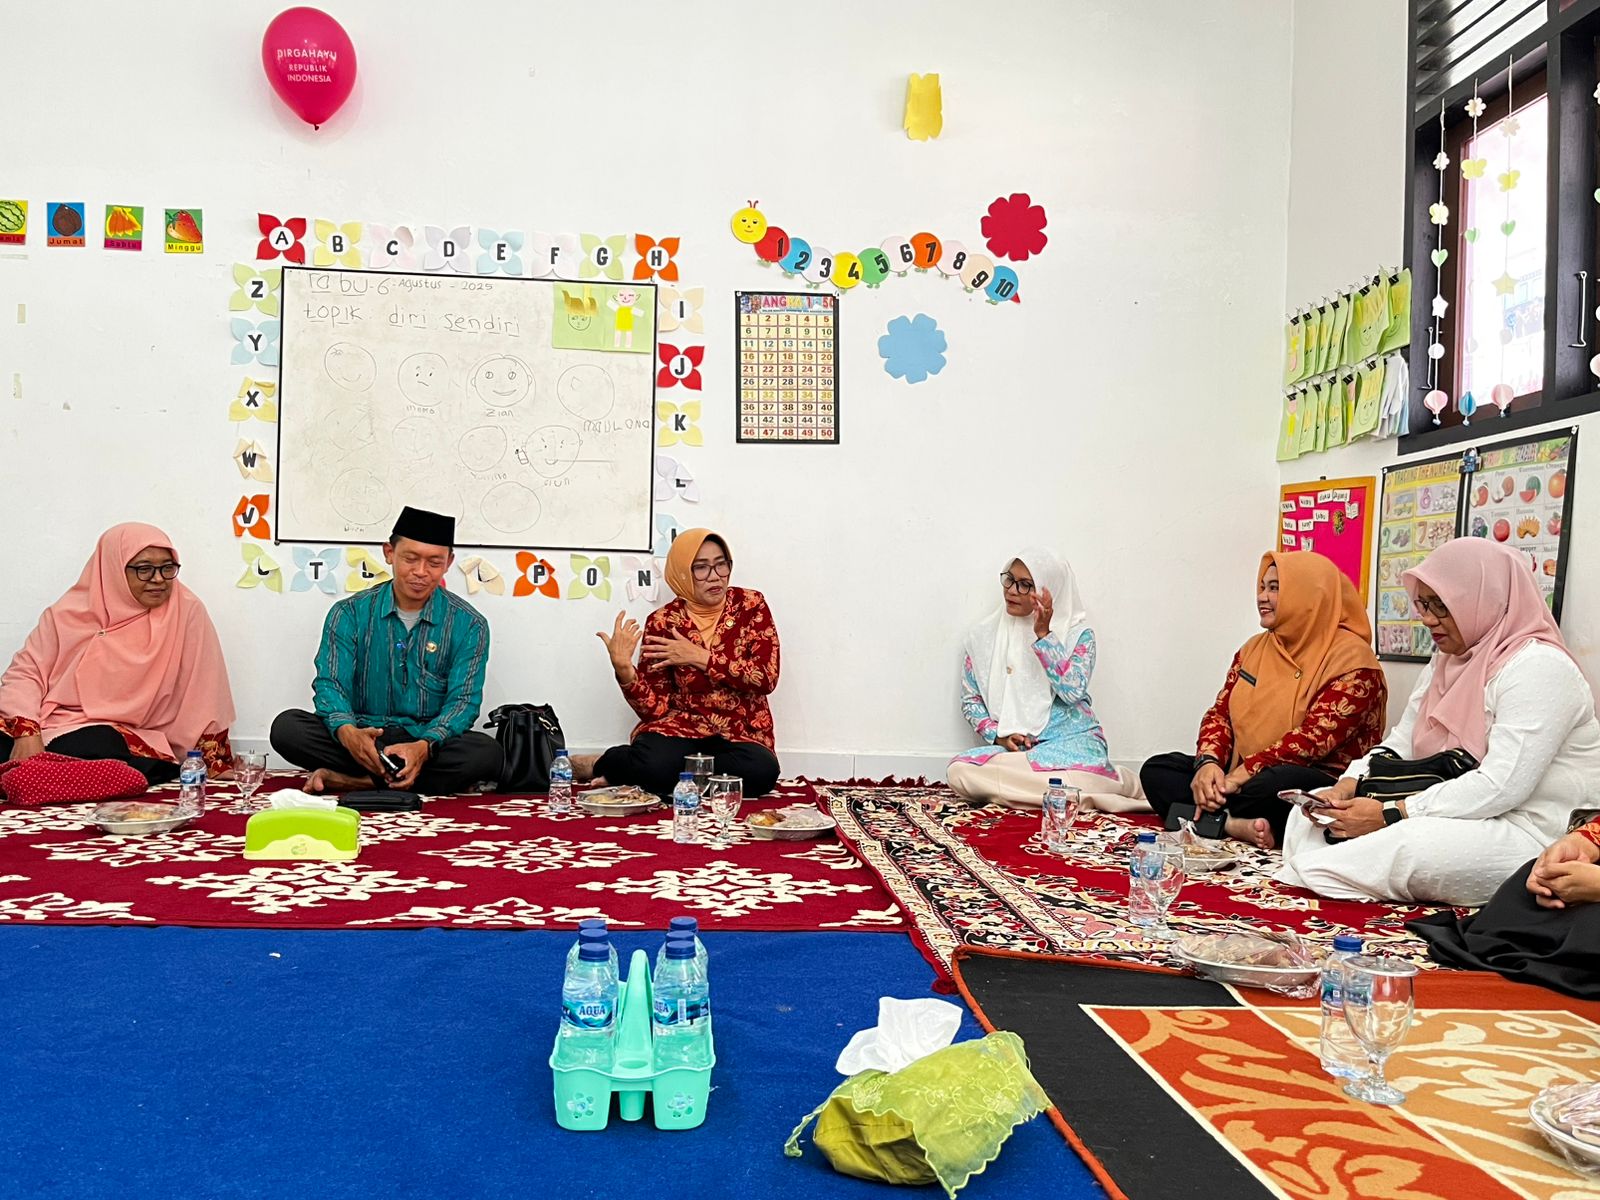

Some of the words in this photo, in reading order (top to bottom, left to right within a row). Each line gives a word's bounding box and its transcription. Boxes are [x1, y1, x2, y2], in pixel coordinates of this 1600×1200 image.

[277, 49, 337, 61] DIRGAHAYU
[289, 64, 327, 72] REPUBLIK
[287, 74, 331, 82] INDONESIA
[275, 231, 289, 245] A
[332, 235, 344, 252] B
[386, 240, 398, 255] C
[443, 241, 455, 257] D
[496, 243, 506, 261] E
[550, 247, 560, 265] F
[596, 247, 609, 266] G
[651, 250, 662, 267] H
[777, 238, 784, 258] 1
[794, 251, 810, 271] 2
[819, 257, 832, 278] 3
[847, 262, 860, 280] 4
[874, 254, 889, 274] 5
[899, 243, 913, 264] 6
[925, 242, 938, 263] 7
[952, 251, 967, 271] 8
[971, 270, 989, 288] 9
[994, 278, 1015, 298] 10
[251, 280, 264, 298] Z
[461, 282, 494, 291] 2025
[304, 303, 363, 328] topik
[389, 305, 426, 324] diri
[679, 300, 685, 319] I
[248, 334, 262, 351] Y
[674, 357, 685, 376] J
[246, 390, 260, 408] X
[674, 414, 686, 431] K
[242, 451, 256, 468] W
[1420, 488, 1432, 510] 6
[242, 507, 255, 524] V
[1382, 527, 1391, 548] 2
[1418, 522, 1428, 544] 7
[309, 562, 324, 580] T
[534, 565, 546, 584] P
[586, 568, 598, 586] O
[638, 570, 652, 587] N
[1381, 560, 1391, 581] 3
[579, 1004, 606, 1016] AQUA
